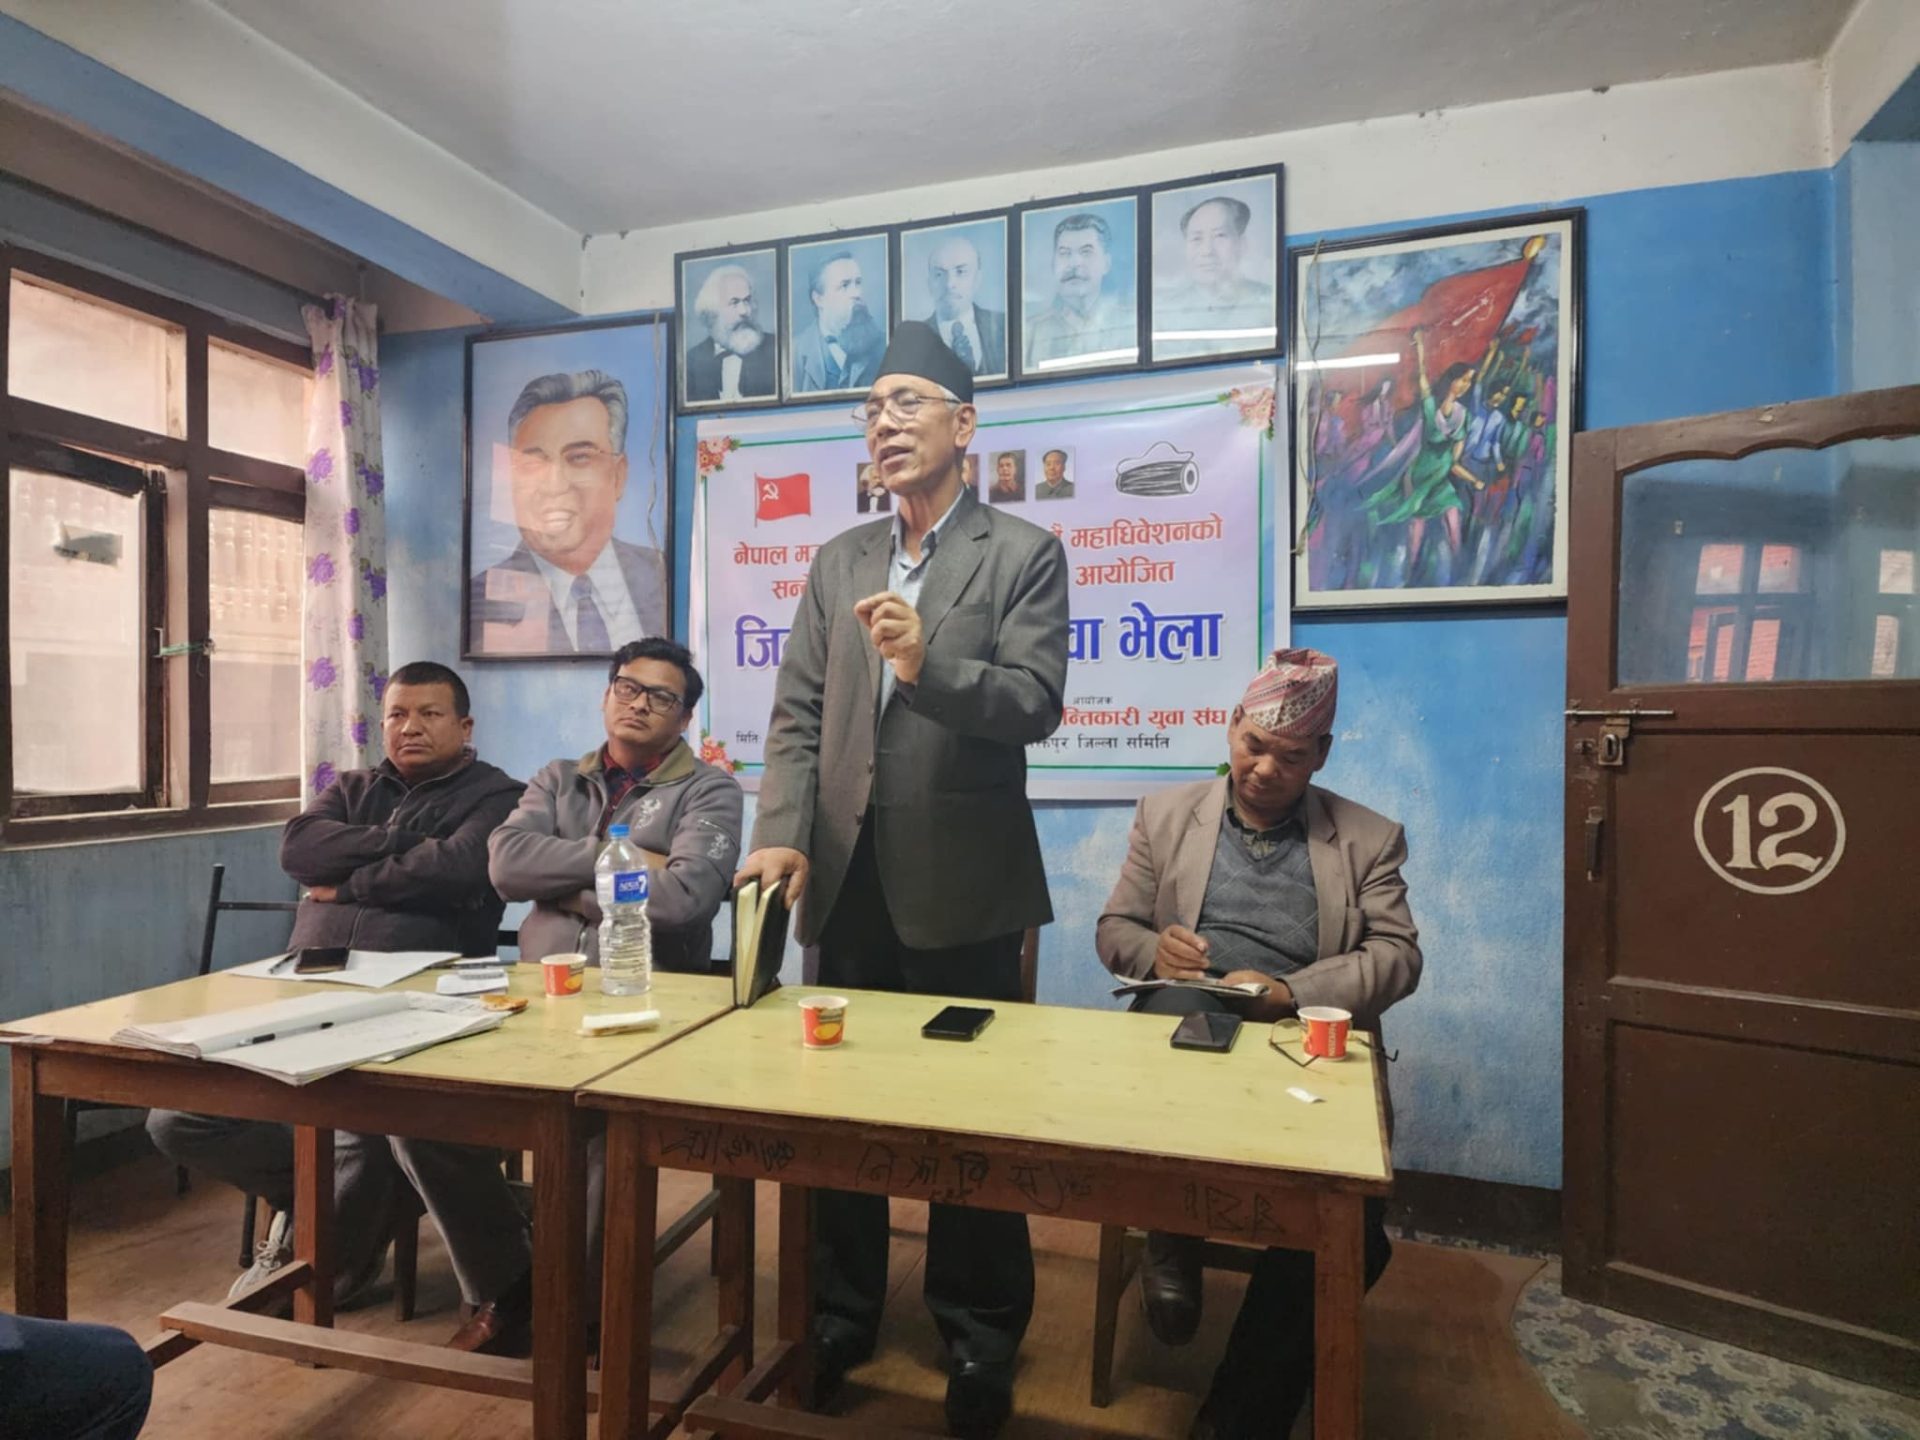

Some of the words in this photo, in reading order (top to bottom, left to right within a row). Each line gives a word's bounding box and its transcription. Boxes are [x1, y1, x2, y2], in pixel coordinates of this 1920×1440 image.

[733, 541, 789, 565] नेपाल
[1070, 512, 1223, 549] महाधिवेशनको
[1075, 556, 1176, 586] आयोजित
[1119, 601, 1224, 661] भेला
[1062, 706, 1140, 727] न्तिकारी
[1148, 709, 1185, 730] युवा
[1192, 706, 1227, 727] संघ
[1077, 733, 1118, 749] जिल्ला
[1126, 732, 1170, 749] समिति
[1721, 791, 1824, 873] 12
